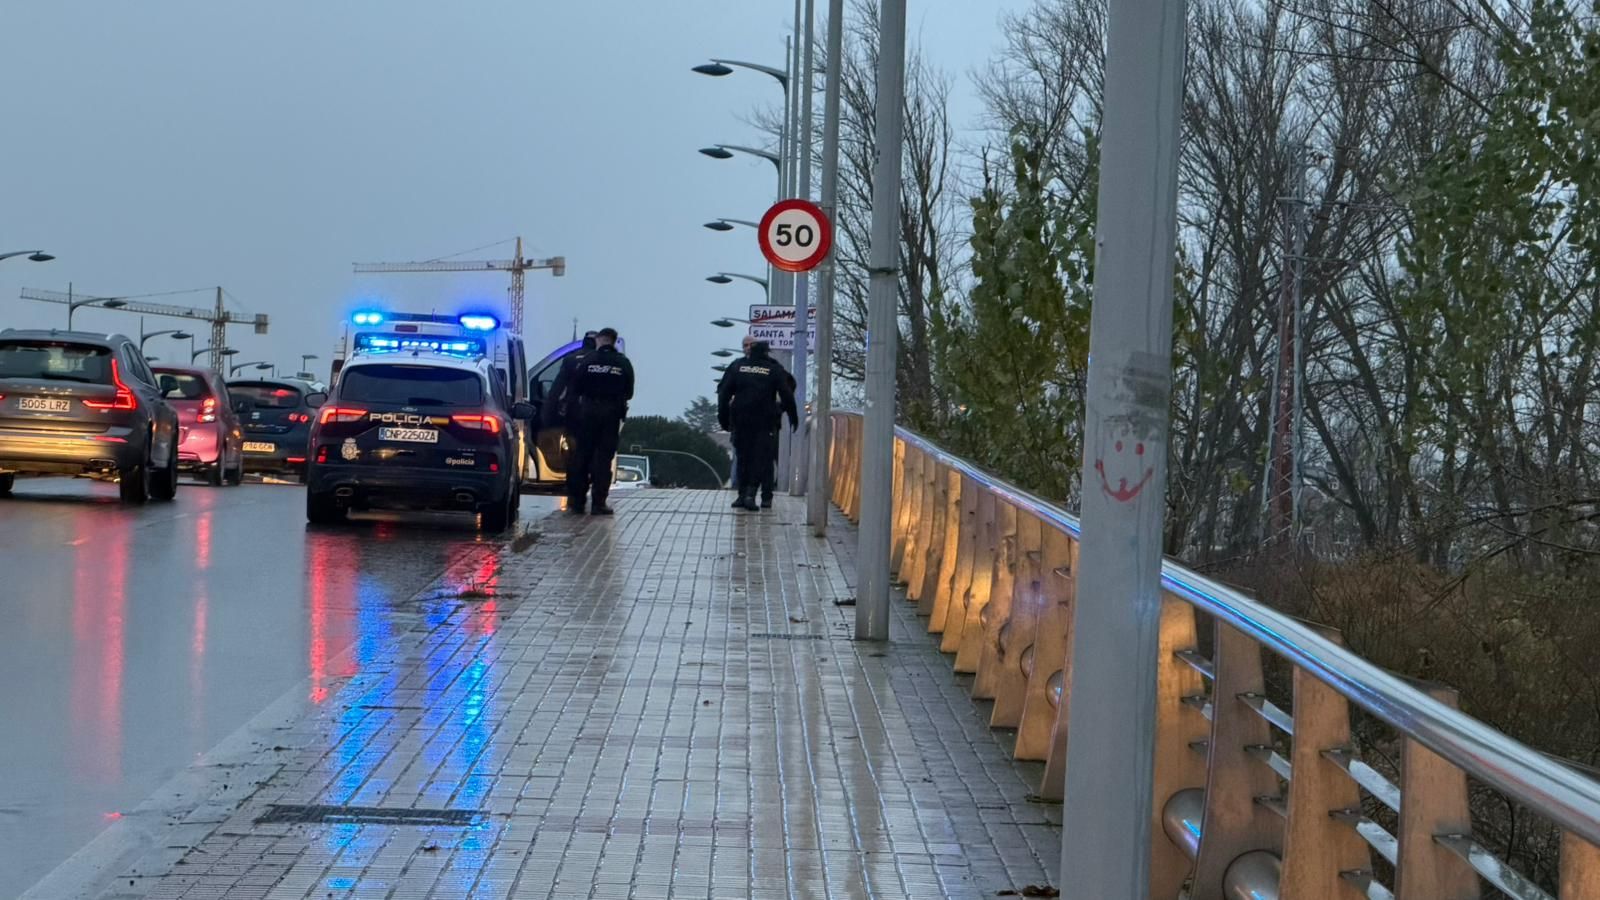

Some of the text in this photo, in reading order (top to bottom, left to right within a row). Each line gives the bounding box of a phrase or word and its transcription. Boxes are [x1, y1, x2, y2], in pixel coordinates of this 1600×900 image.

[776, 224, 813, 247] 50
[753, 329, 784, 339] SANTA
[21, 399, 68, 411] 5005 LRZ
[369, 413, 432, 424] POLICIA
[384, 428, 436, 441] CNP2250ZA
[445, 457, 475, 467] @policia
